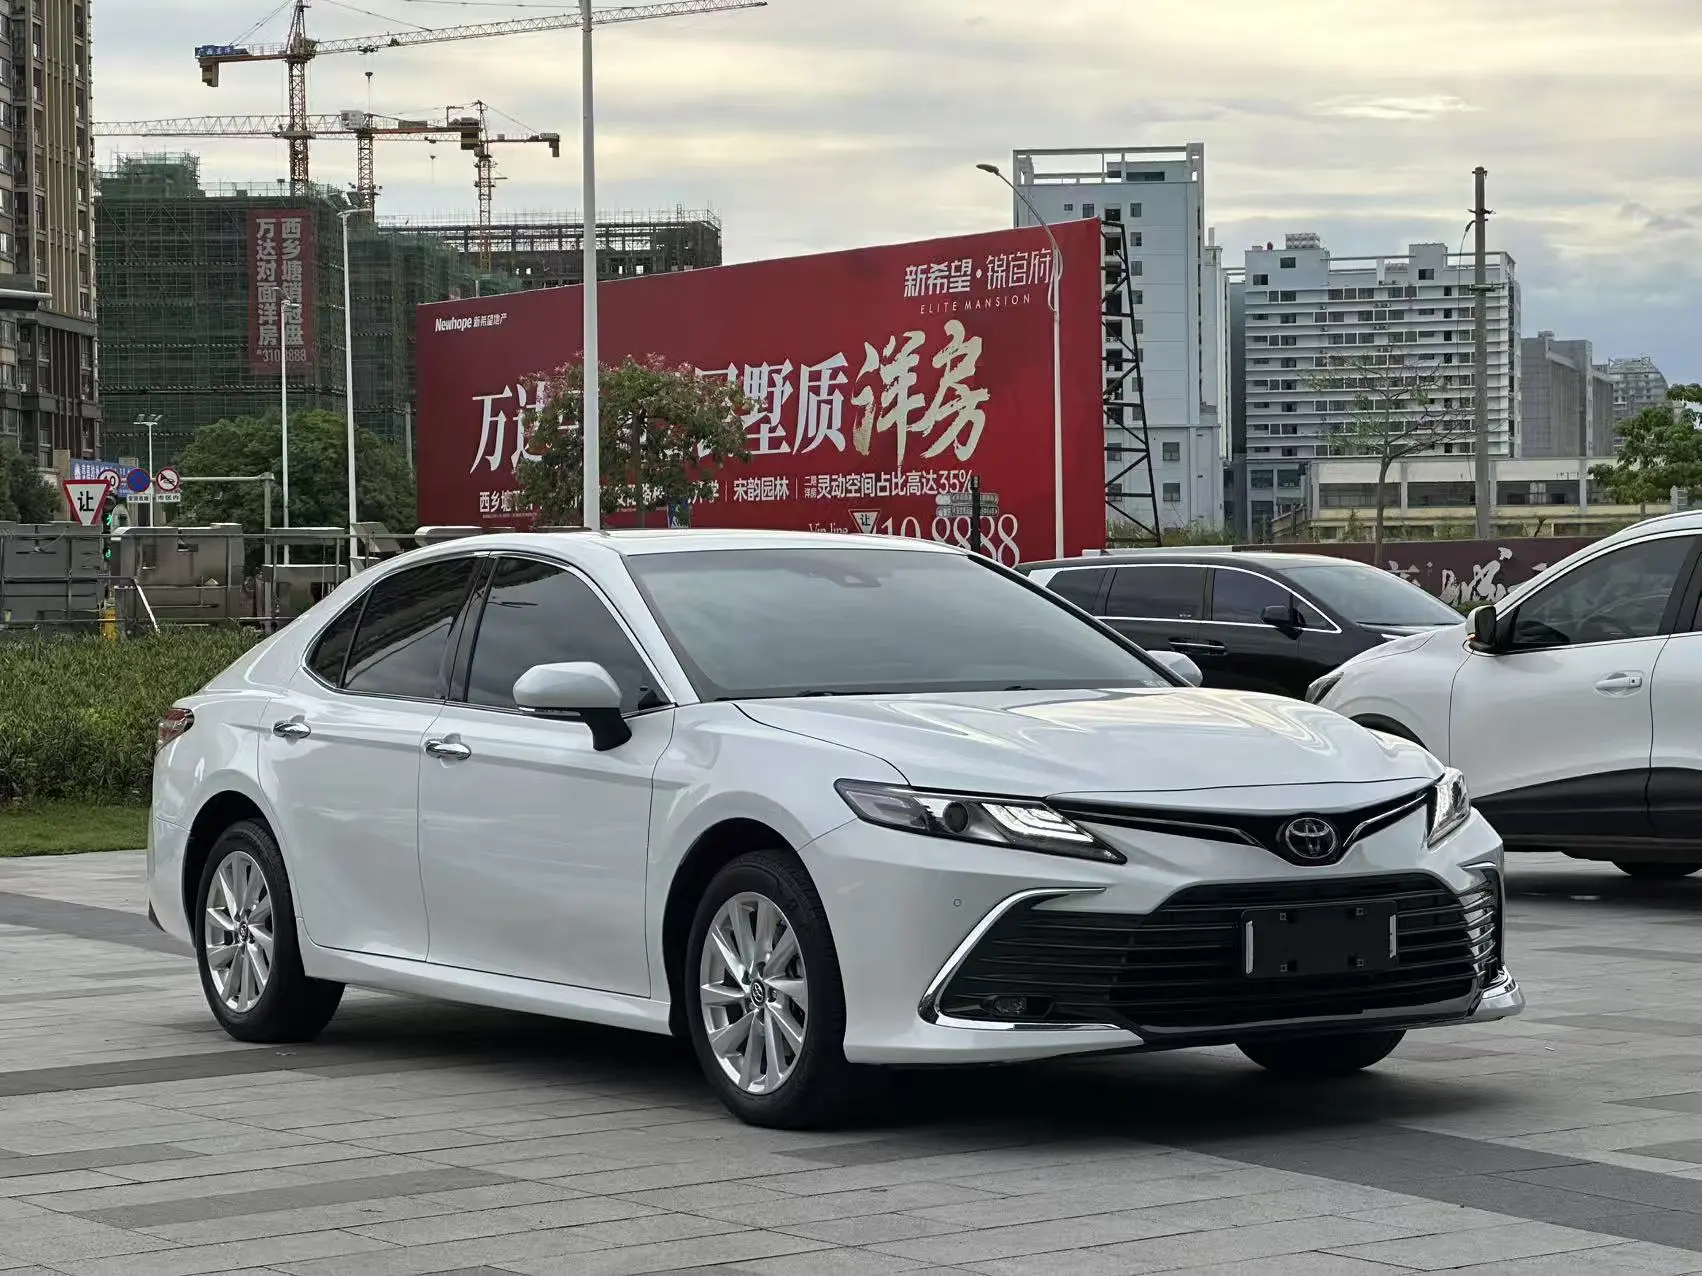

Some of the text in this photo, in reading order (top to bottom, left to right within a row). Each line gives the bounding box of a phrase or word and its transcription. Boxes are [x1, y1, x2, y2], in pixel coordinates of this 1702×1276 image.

[256, 218, 278, 346] 万达对面洋房
[920, 294, 1031, 314] ELITE MANSION
[435, 313, 507, 332] Newhope 新希望地产
[733, 475, 790, 502] 宋韵园林
[77, 490, 95, 512] 让
[859, 513, 872, 527] 让
